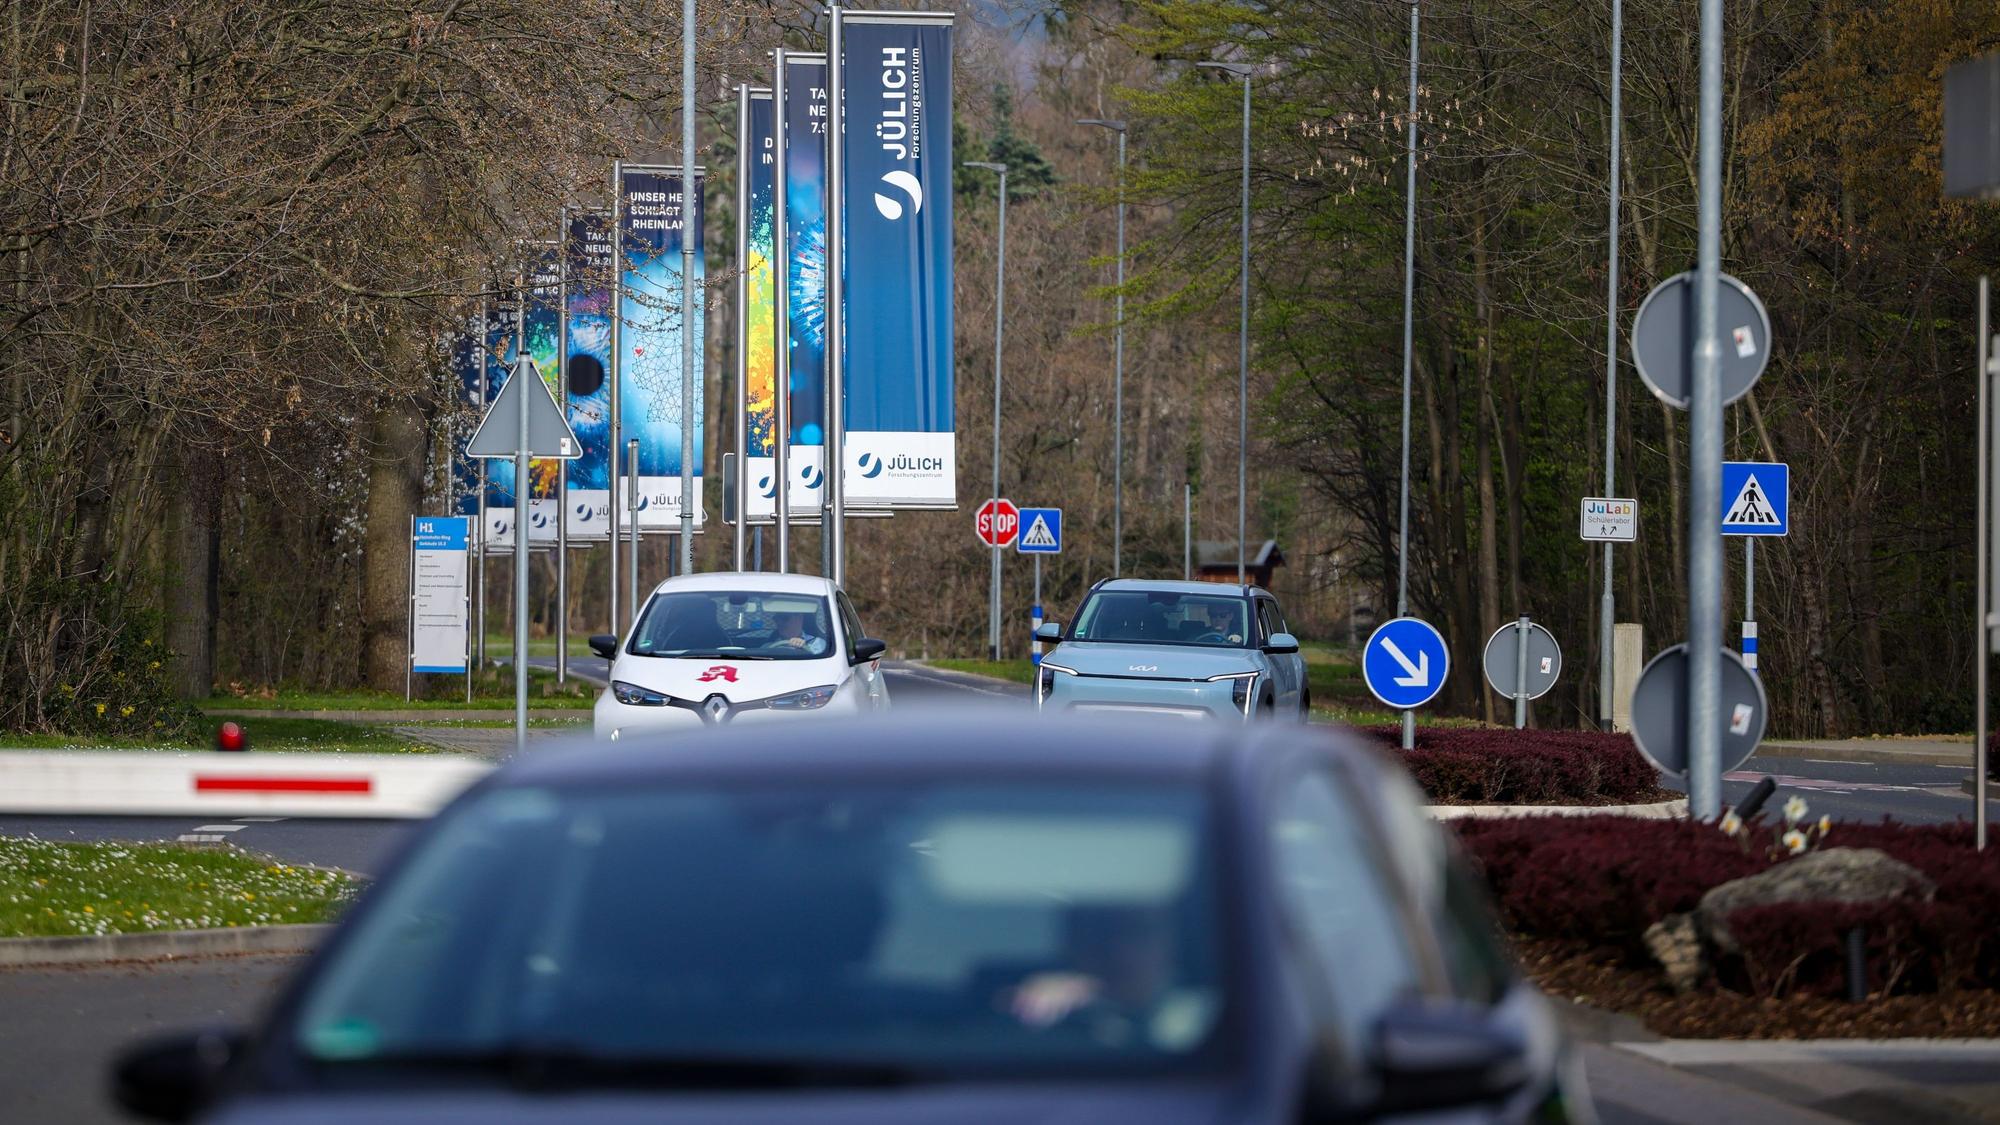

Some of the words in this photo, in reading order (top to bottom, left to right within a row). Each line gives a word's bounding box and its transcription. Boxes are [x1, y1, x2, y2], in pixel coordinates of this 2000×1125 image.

[876, 47, 907, 160] JÜLICH
[911, 48, 921, 159] Forschungszentrum
[630, 192, 666, 202] UNSER
[630, 204, 680, 216] SCHLÄGT
[632, 219, 684, 230] RHEINLAN
[585, 244, 612, 254] NEUG
[887, 453, 943, 471] JÜLICH
[652, 493, 683, 505] JÜLIC
[1587, 501, 1632, 515] JuLab
[1587, 515, 1631, 524] Schülerlabor
[419, 522, 434, 533] H1
